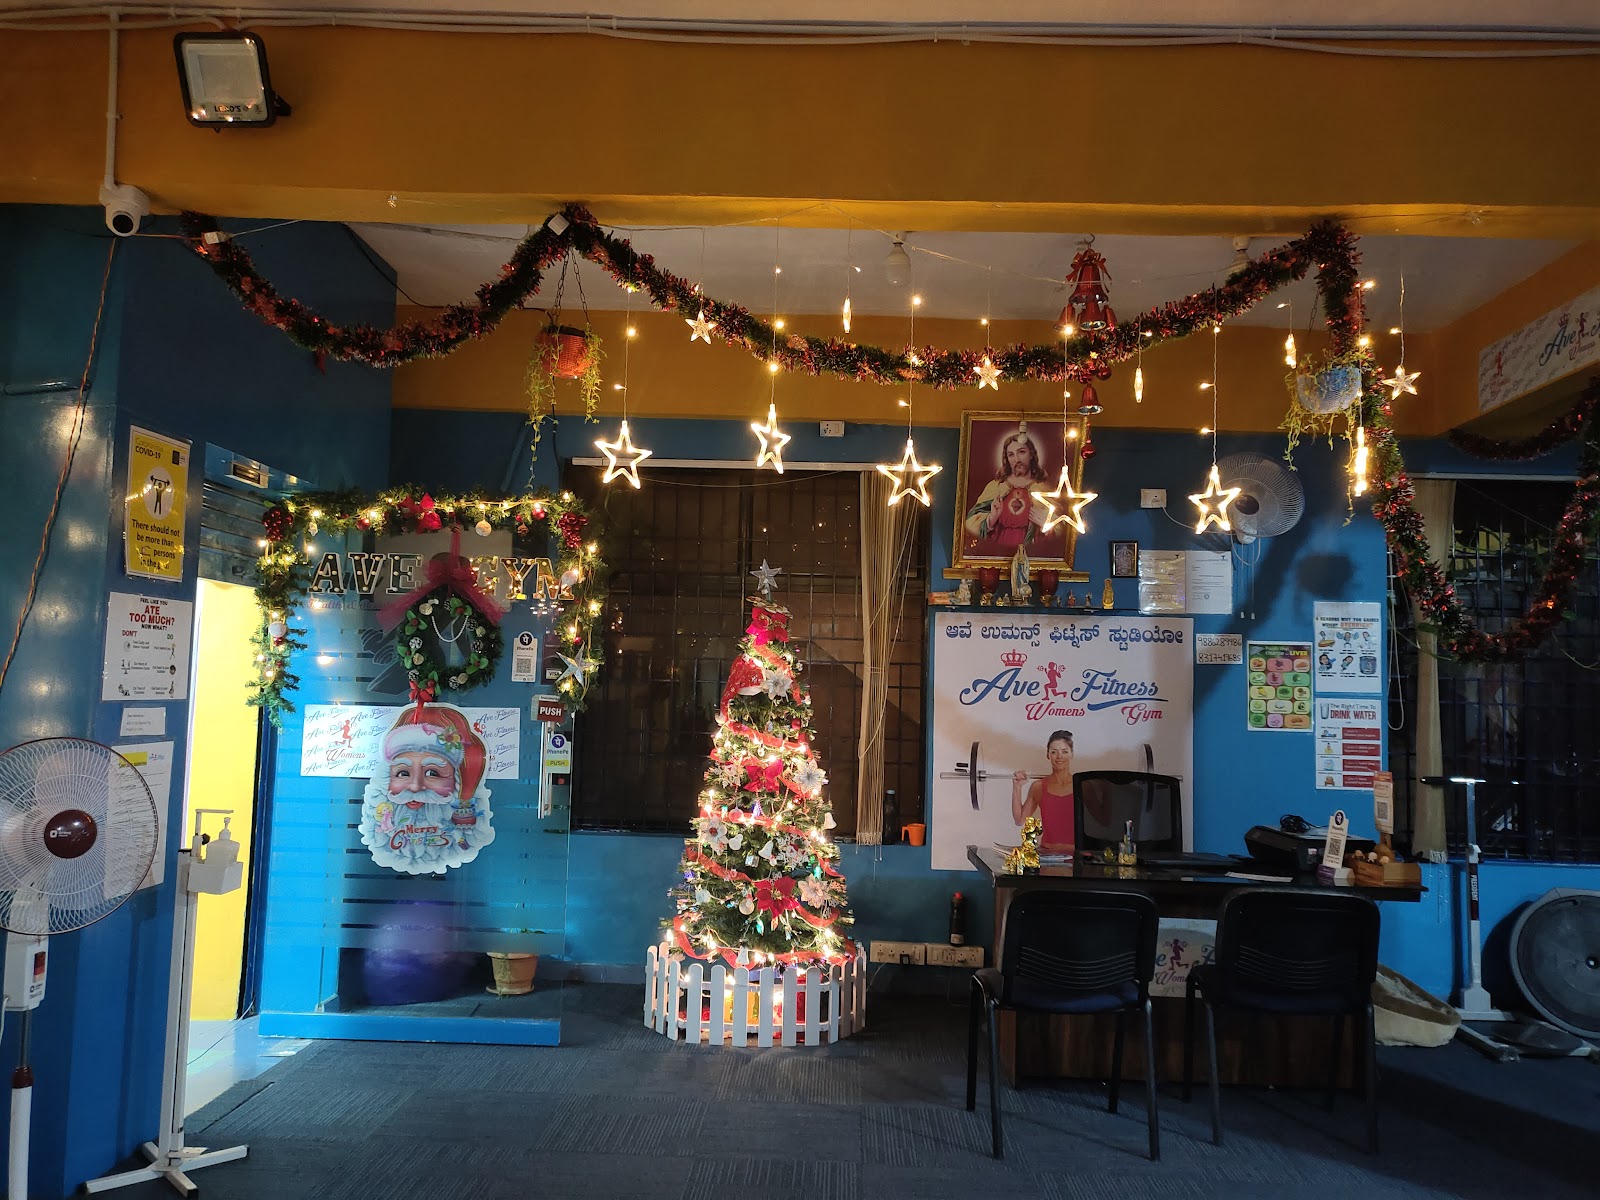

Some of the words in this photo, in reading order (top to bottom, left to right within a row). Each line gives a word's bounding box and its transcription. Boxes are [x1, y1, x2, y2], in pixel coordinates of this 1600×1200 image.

[136, 446, 161, 459] COVID-19
[132, 519, 149, 531] There
[151, 524, 170, 535] should
[137, 532, 144, 541] be
[146, 536, 160, 545] more
[162, 538, 174, 547] than
[154, 550, 176, 559] persons
[148, 559, 157, 567] the
[307, 552, 424, 594] AVE
[470, 555, 575, 600] GYM
[145, 605, 160, 615] ATE
[129, 613, 146, 623] TOO
[149, 616, 175, 626] MUCH?
[946, 622, 972, 639] ಆವೆ
[959, 667, 1041, 706] Ave
[1071, 669, 1159, 702] Fitness
[540, 707, 562, 716] PUSH
[1025, 702, 1086, 721] Womens
[1122, 704, 1163, 726] Gym
[1331, 710, 1351, 719] DRINK
[1354, 711, 1377, 720] WATER
[351, 712, 368, 727] Ave
[476, 714, 493, 723] Ave
[326, 749, 366, 761] Womens
[406, 825, 439, 834] Merry
[1155, 971, 1190, 985] Wom
